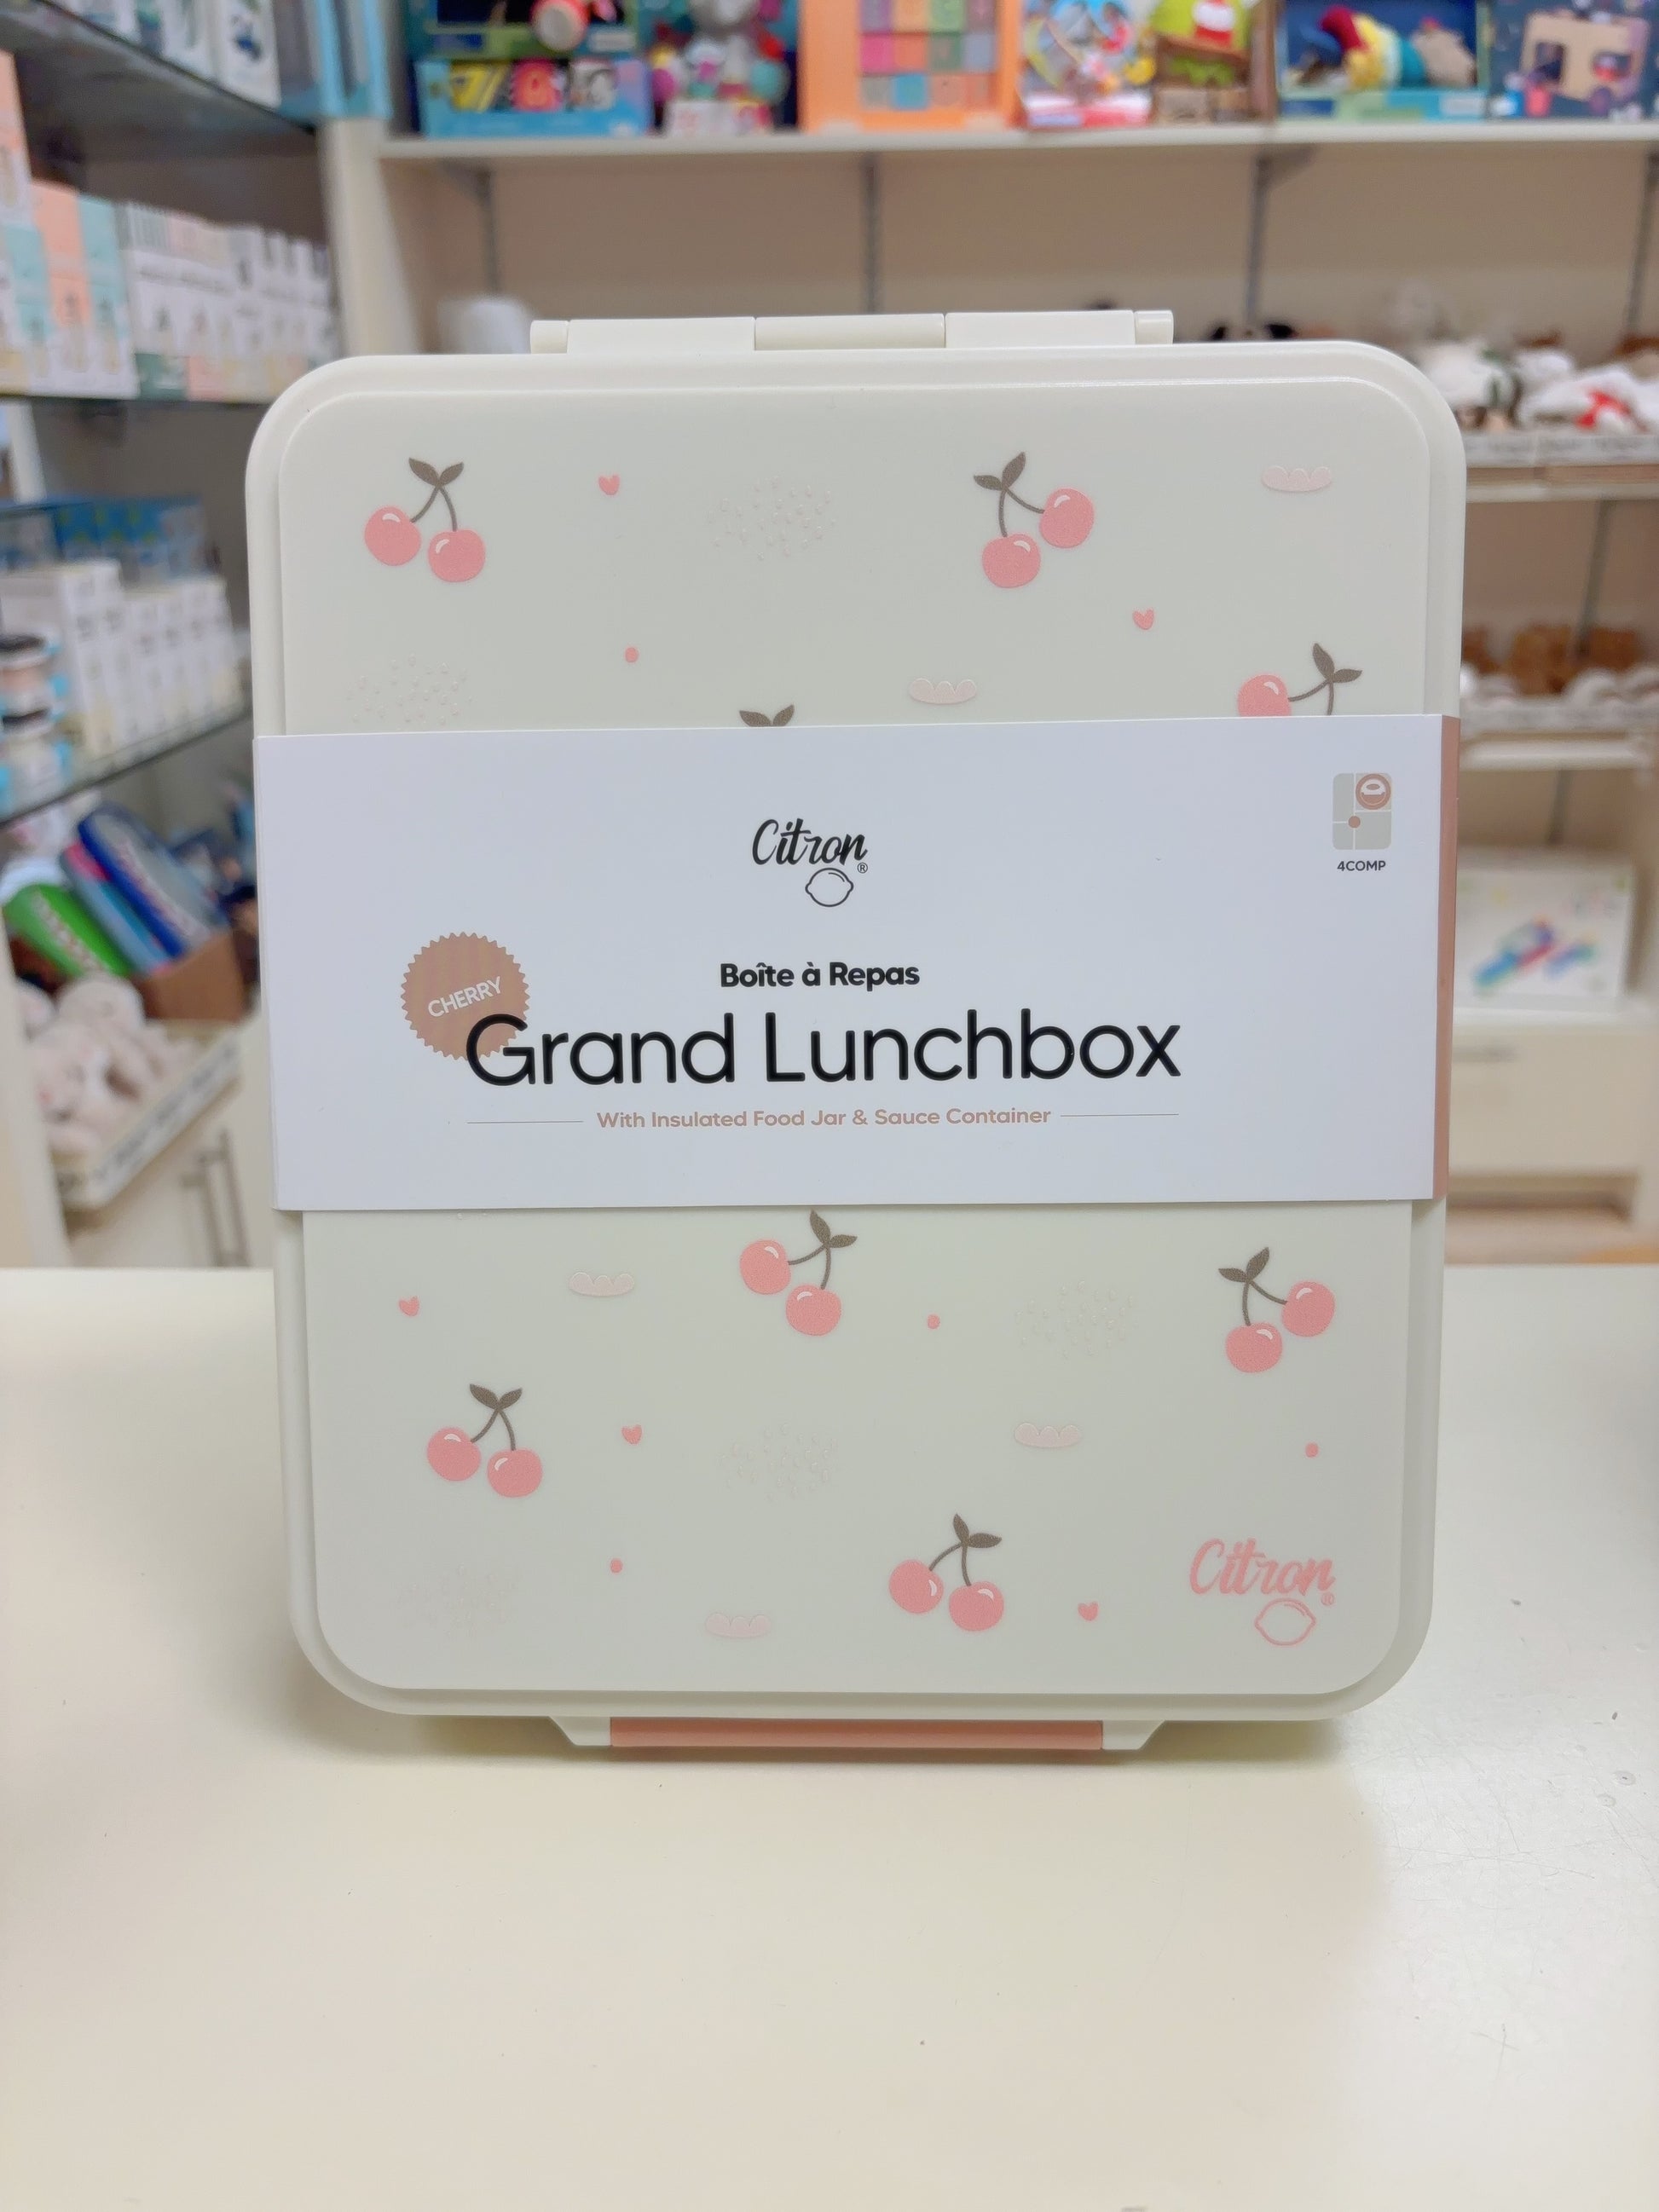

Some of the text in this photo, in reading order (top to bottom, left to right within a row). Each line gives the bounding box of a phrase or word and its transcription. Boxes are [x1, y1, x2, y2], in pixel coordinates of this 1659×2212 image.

[752, 818, 868, 865] Citron
[1337, 860, 1386, 871] 4COMP
[427, 976, 503, 1018] CHERRY
[720, 962, 921, 991] Boîte à Repas
[466, 1008, 1182, 1087] Grand Lunchbox
[597, 1107, 1052, 1129] With Insulated Food Jar & Sauce Container
[1190, 1538, 1336, 1596] Citron
